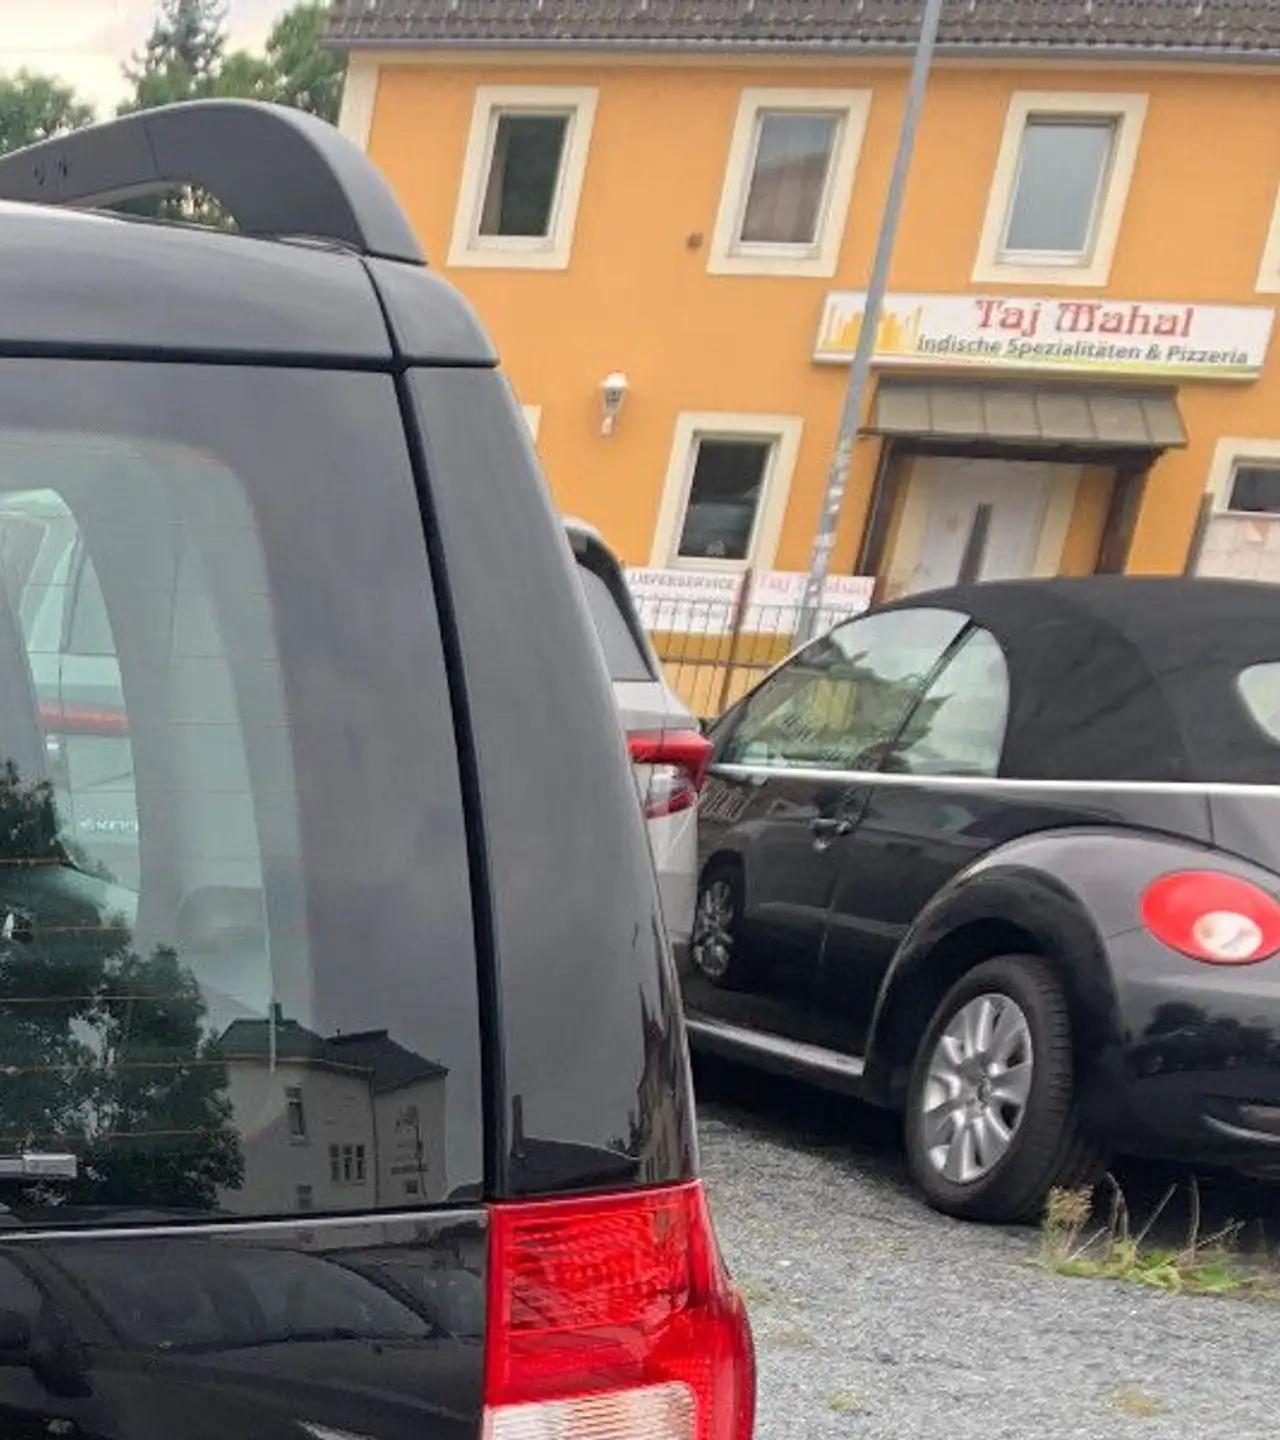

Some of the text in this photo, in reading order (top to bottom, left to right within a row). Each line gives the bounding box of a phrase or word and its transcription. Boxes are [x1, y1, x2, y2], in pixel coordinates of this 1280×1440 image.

[974, 298, 1195, 338] Taj Mahal
[917, 333, 1248, 365] Indische Spezialitäten & Pizzeria
